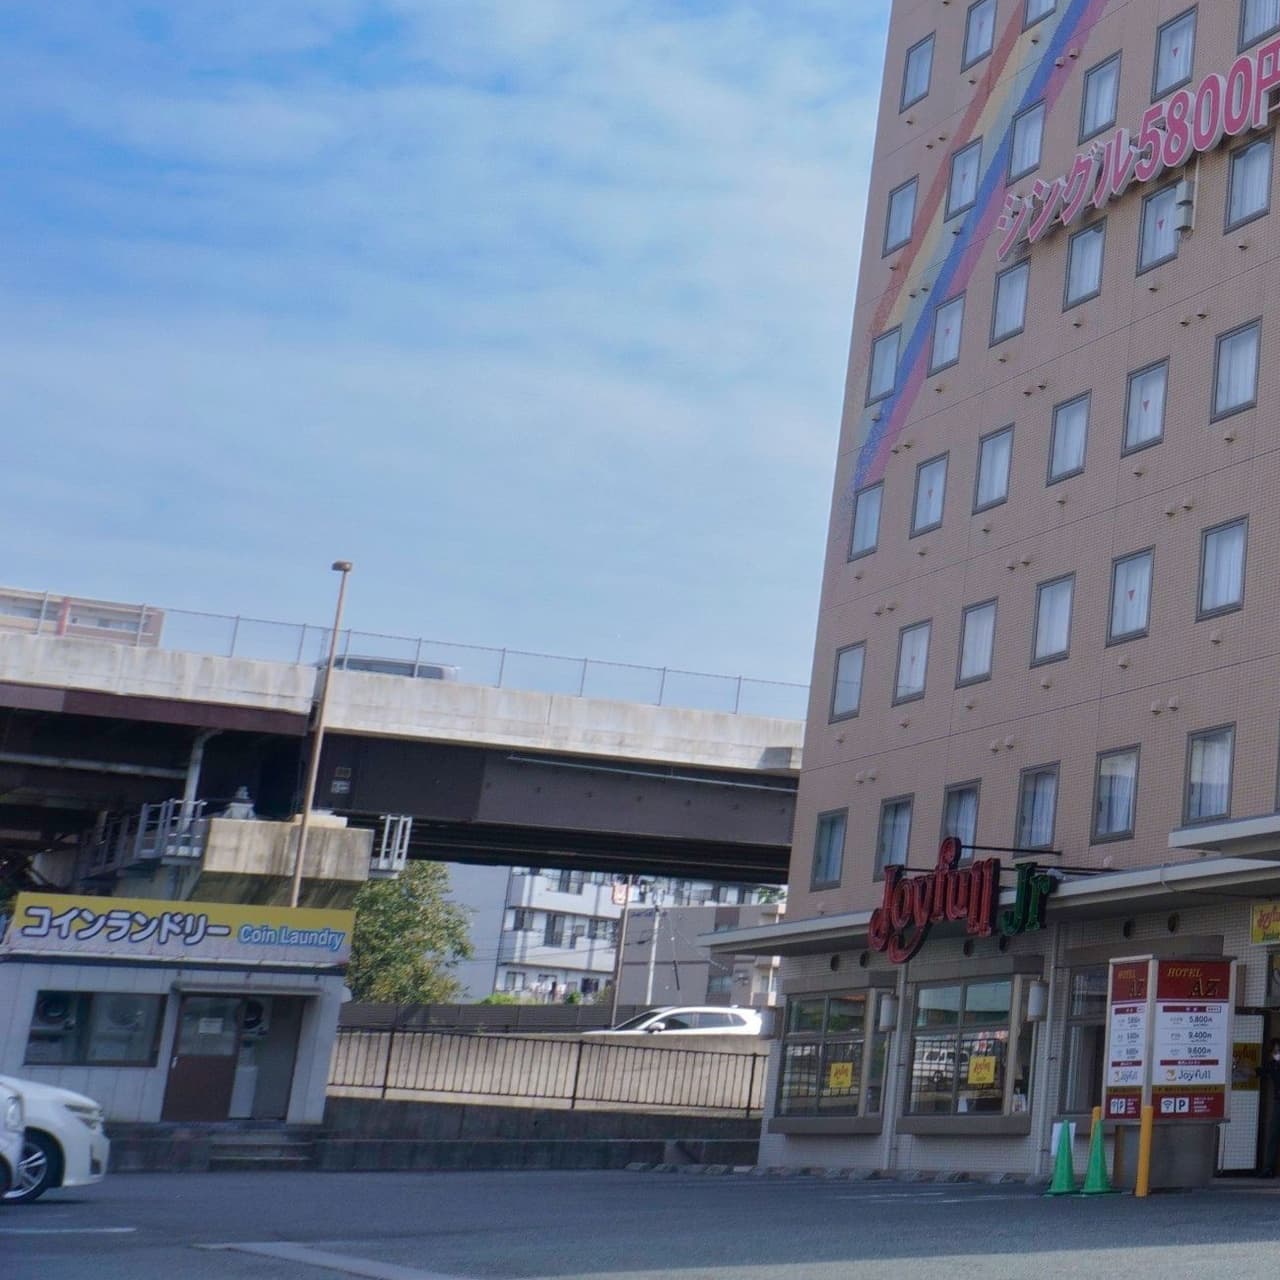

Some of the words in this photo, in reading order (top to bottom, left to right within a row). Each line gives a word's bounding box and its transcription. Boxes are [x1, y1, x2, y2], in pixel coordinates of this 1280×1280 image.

[869, 837, 1000, 964] Joyfull
[1003, 862, 1058, 936] Jr
[22, 905, 231, 945] コインランドリー
[238, 924, 276, 944] Coin
[281, 926, 345, 951] Laundry
[1167, 967, 1202, 978] HOTEL
[1178, 1069, 1211, 1081] Joyfull
